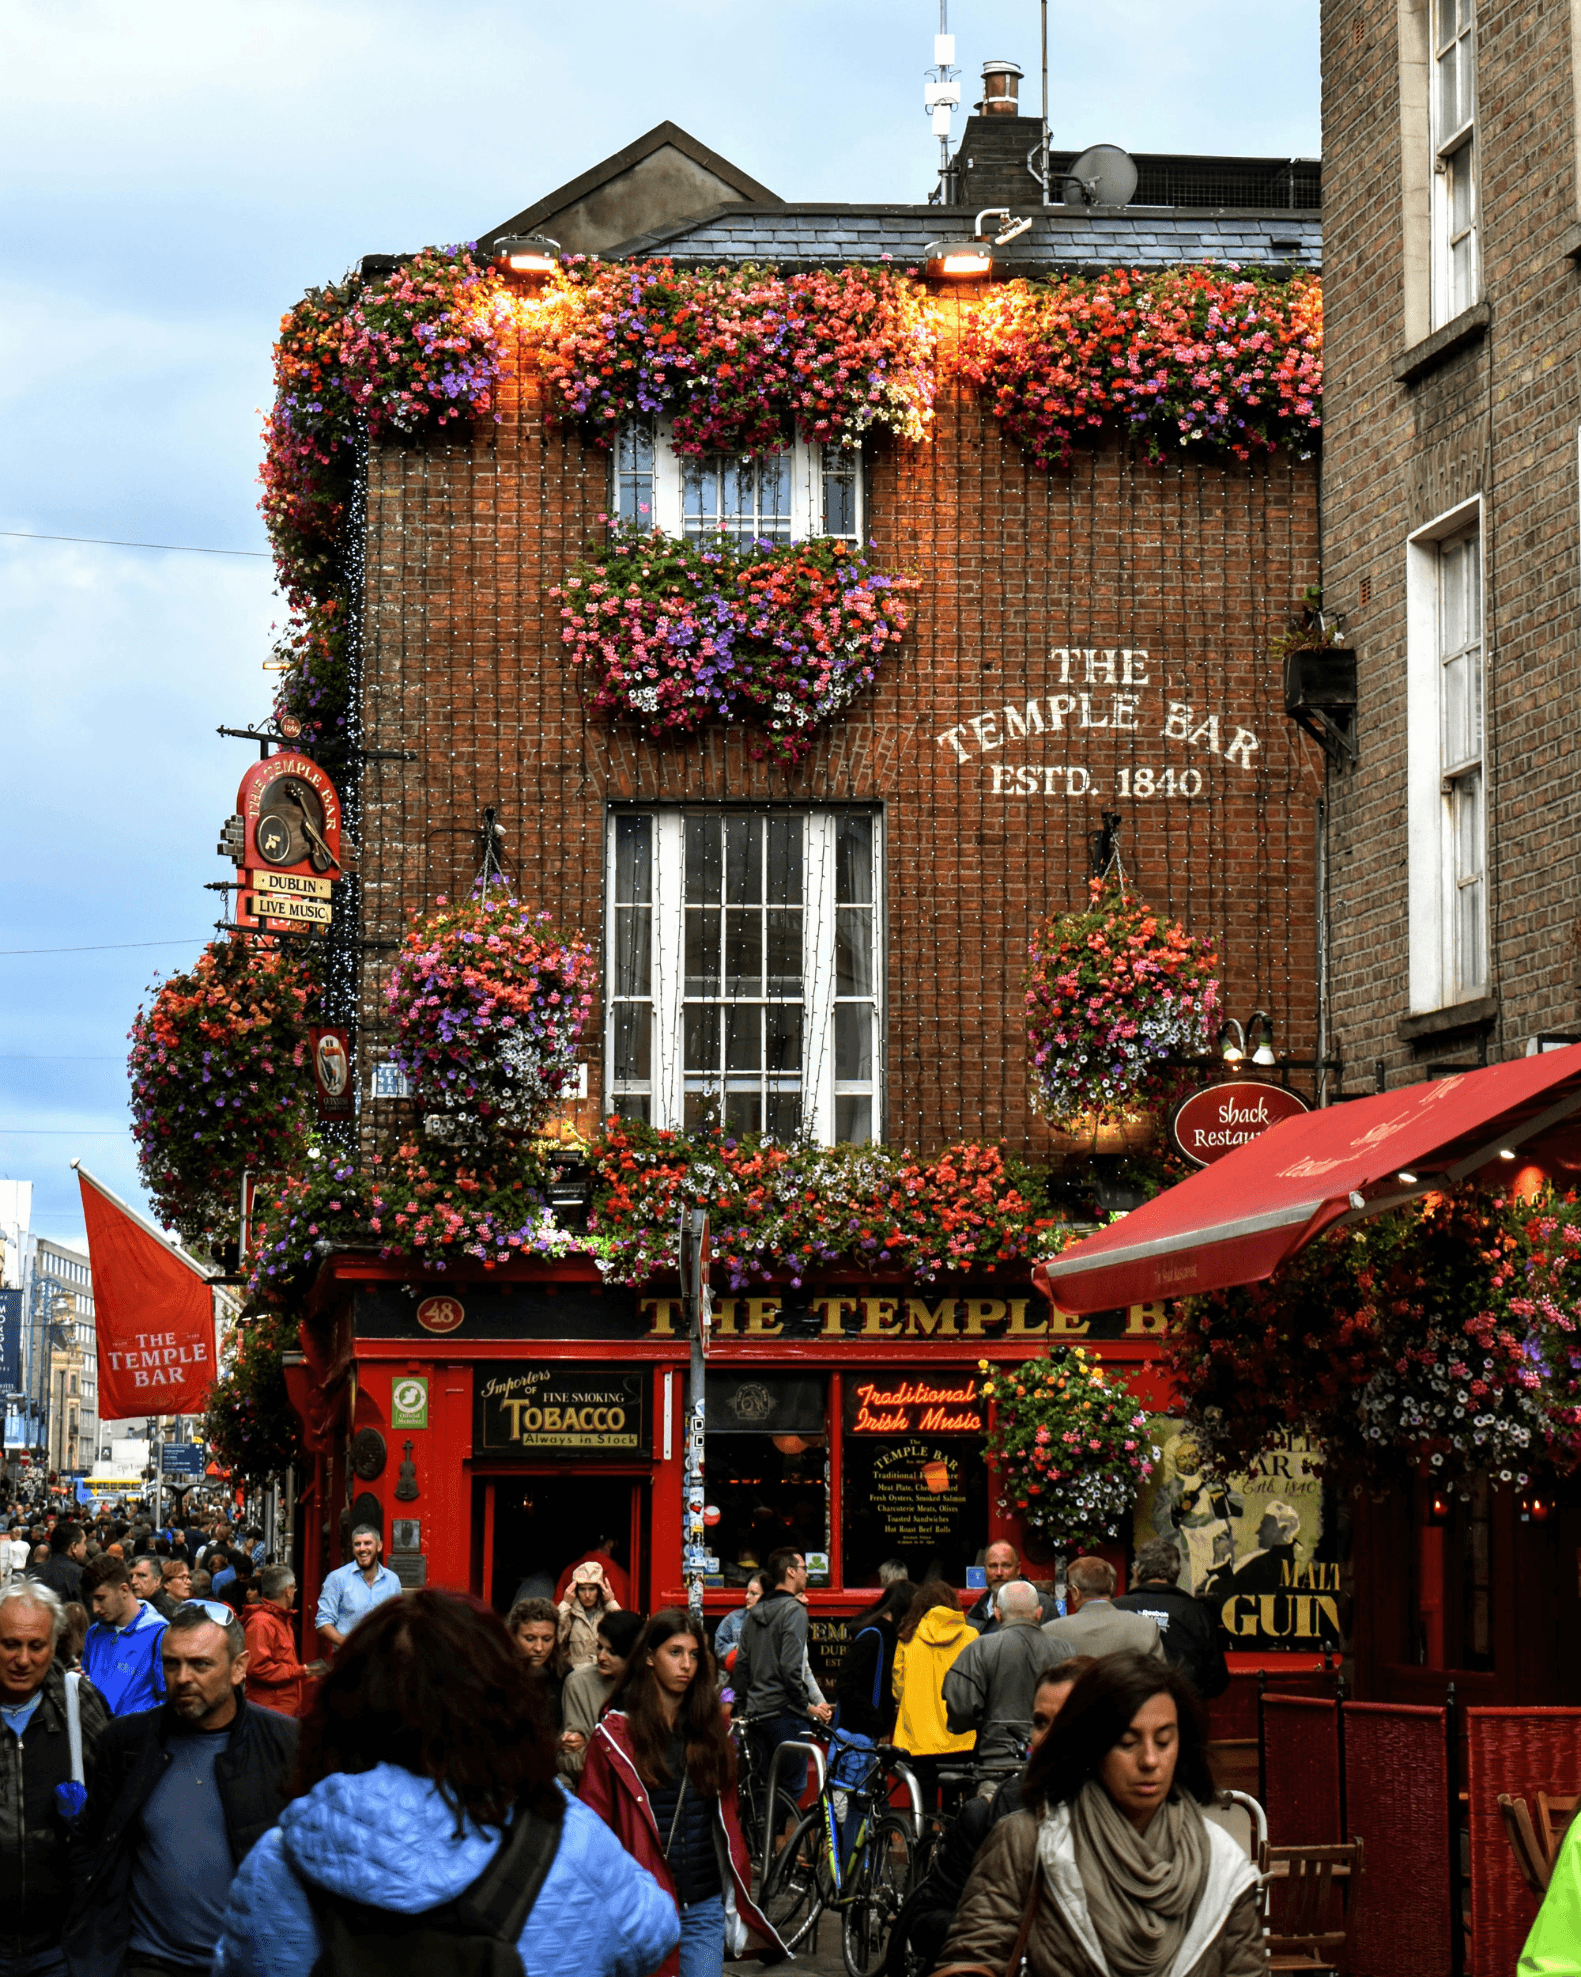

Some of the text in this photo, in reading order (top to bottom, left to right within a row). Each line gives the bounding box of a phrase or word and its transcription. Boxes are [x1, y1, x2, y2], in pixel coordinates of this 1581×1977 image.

[1051, 648, 1149, 684] THE
[937, 693, 1262, 769] TEMPLE BAR
[990, 765, 1203, 797] ESTD. 1840
[249, 759, 337, 830] THE TEMPLE BAR
[269, 875, 316, 893] DUBLIN
[259, 900, 326, 919] LIVE MUSIC
[1218, 1096, 1270, 1126] Shack
[424, 1302, 454, 1325] 48
[640, 1297, 784, 1335] THE
[813, 1297, 1091, 1335] TEMPLE
[135, 1332, 177, 1348] THE
[107, 1343, 208, 1370] TEMPLE
[134, 1367, 186, 1388] BAR
[481, 1369, 551, 1398] Importers
[524, 1386, 538, 1395] OF
[543, 1392, 625, 1403] FINE SMOKING
[857, 1379, 977, 1406] Traditional
[853, 1406, 982, 1432] Irish Music
[525, 1433, 636, 1445] Always in Stock
[873, 1446, 959, 1471] TEMPLE BAR
[873, 1470, 917, 1479] Traditional
[878, 1483, 894, 1492] Meat
[896, 1483, 914, 1492] Plate,
[869, 1493, 967, 1504] Fresh Oysters, Smoked Salmon
[877, 1504, 915, 1512] Charcuterie
[938, 1504, 958, 1512] Olives
[884, 1524, 951, 1533] Hot Roast Beef Rolls
[887, 1514, 949, 1522] Toasted Sandwiches
